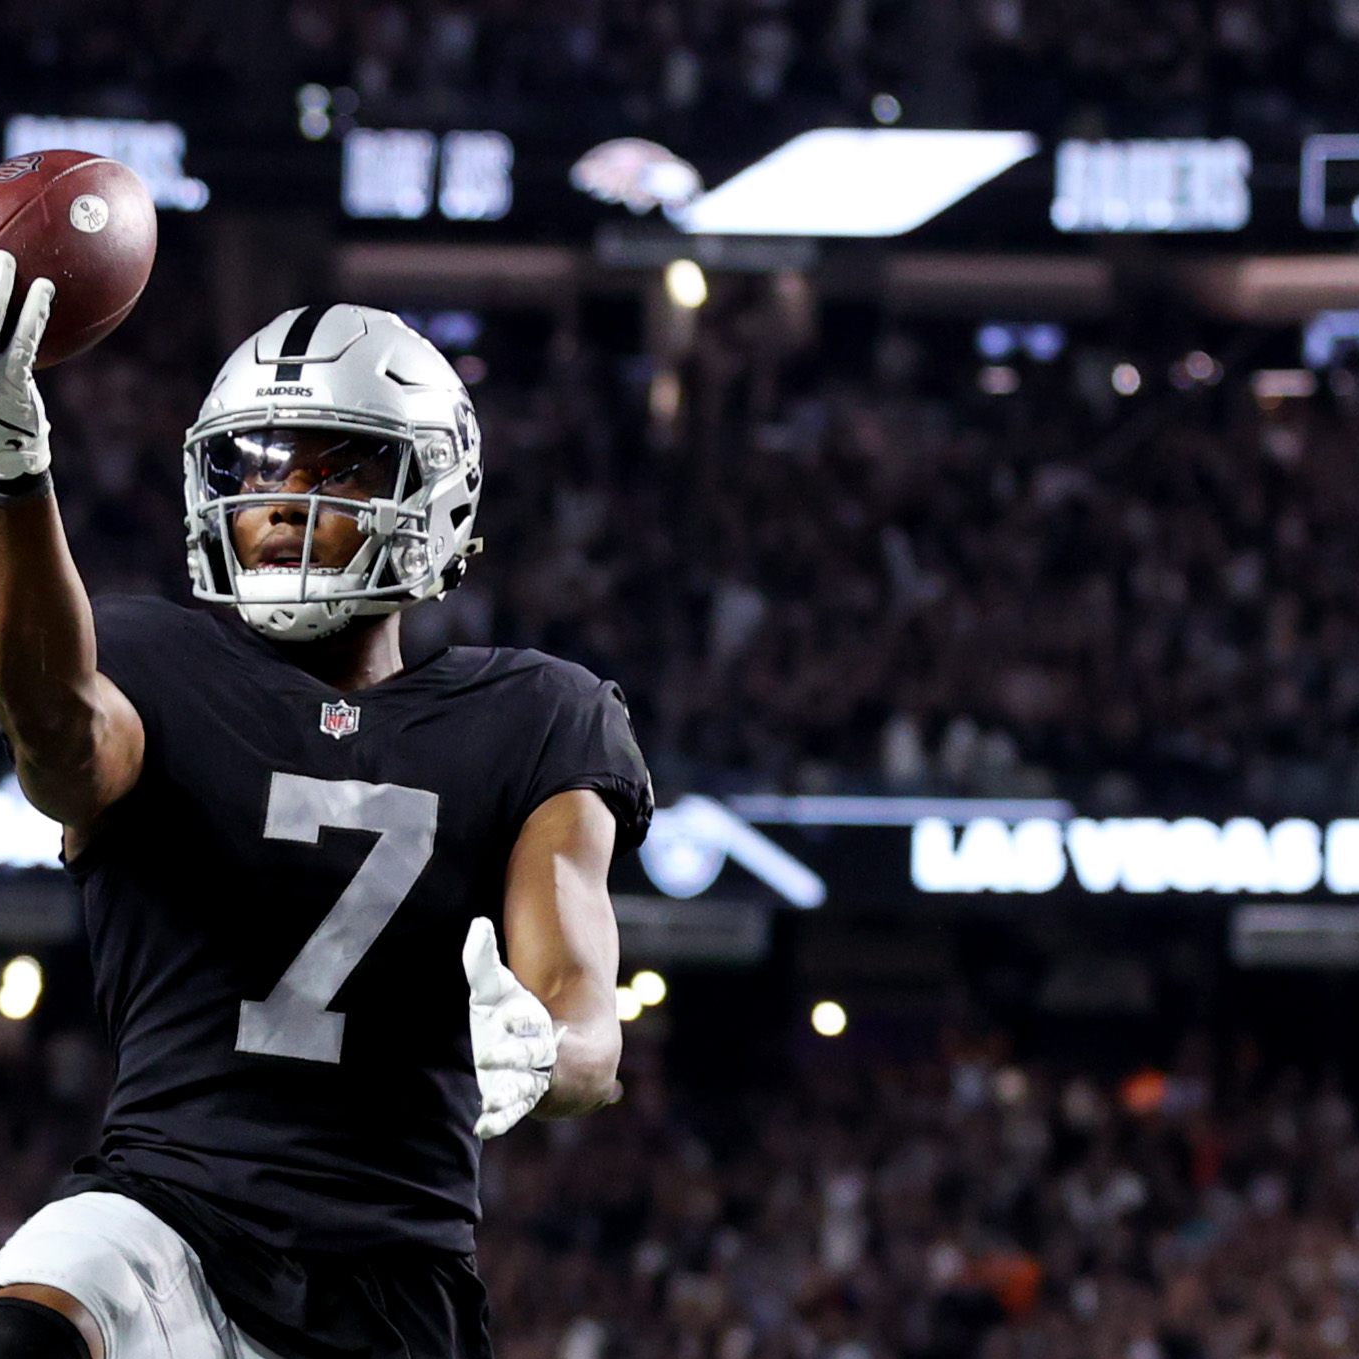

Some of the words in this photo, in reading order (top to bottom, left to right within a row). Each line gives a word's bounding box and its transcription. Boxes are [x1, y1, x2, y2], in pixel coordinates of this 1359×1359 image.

[83, 208, 105, 230] 205
[255, 386, 313, 397] RAIDERS
[911, 816, 1067, 893] LAS
[1066, 816, 1323, 894] VEGAS
[235, 771, 439, 1064] 7
